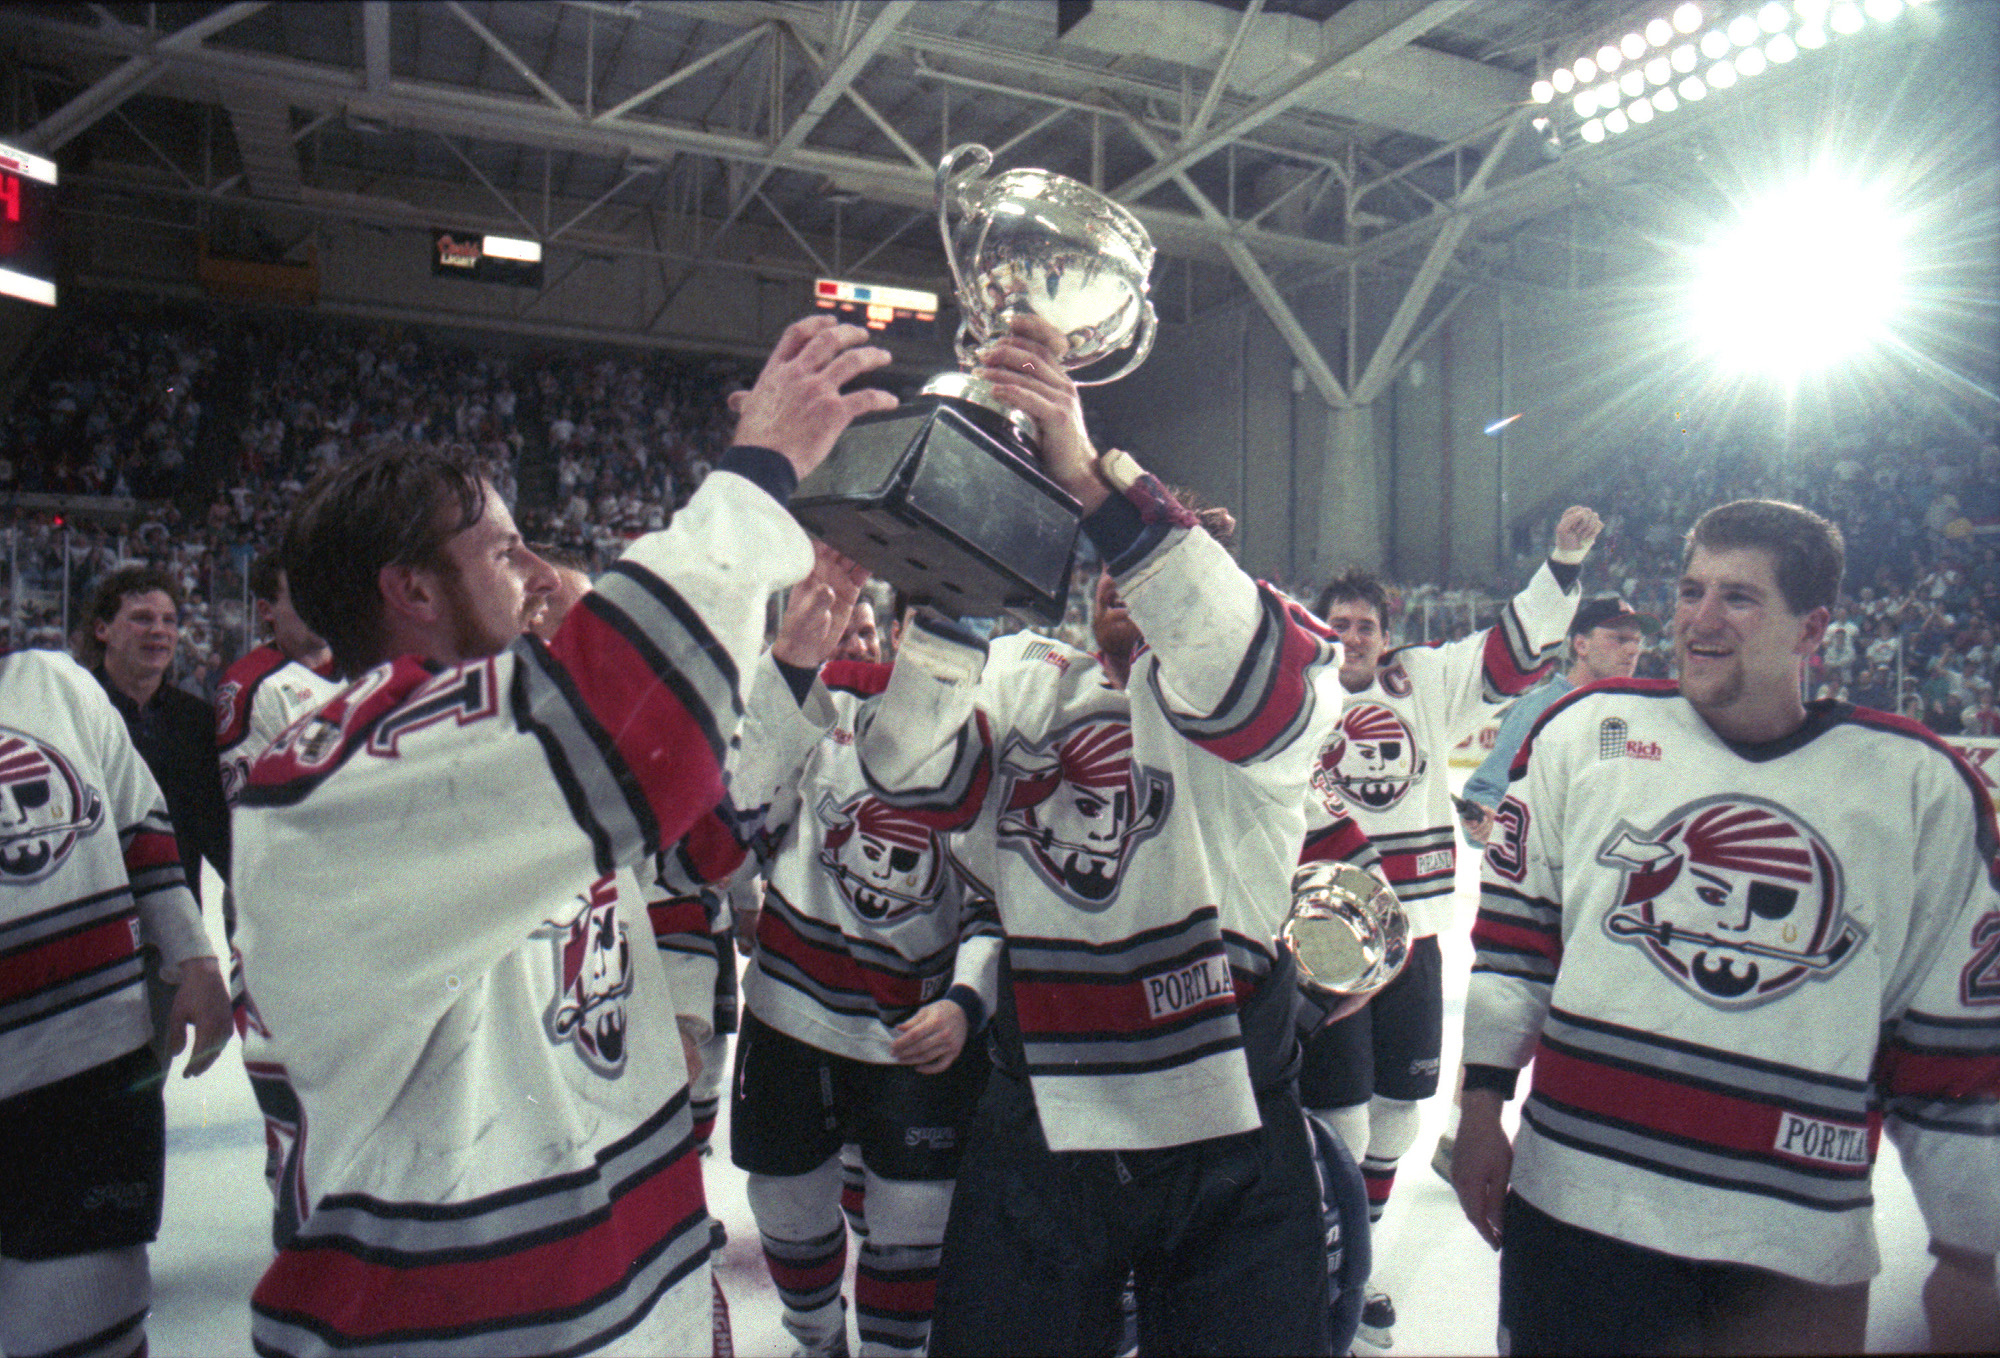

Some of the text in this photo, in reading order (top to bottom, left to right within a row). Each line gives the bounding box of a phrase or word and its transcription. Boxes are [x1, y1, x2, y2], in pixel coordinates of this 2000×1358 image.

[1378, 660, 1414, 699] C
[1625, 740, 1663, 756] Rich
[1484, 794, 1531, 884] 3
[1781, 1116, 1866, 1163] PORTLA
